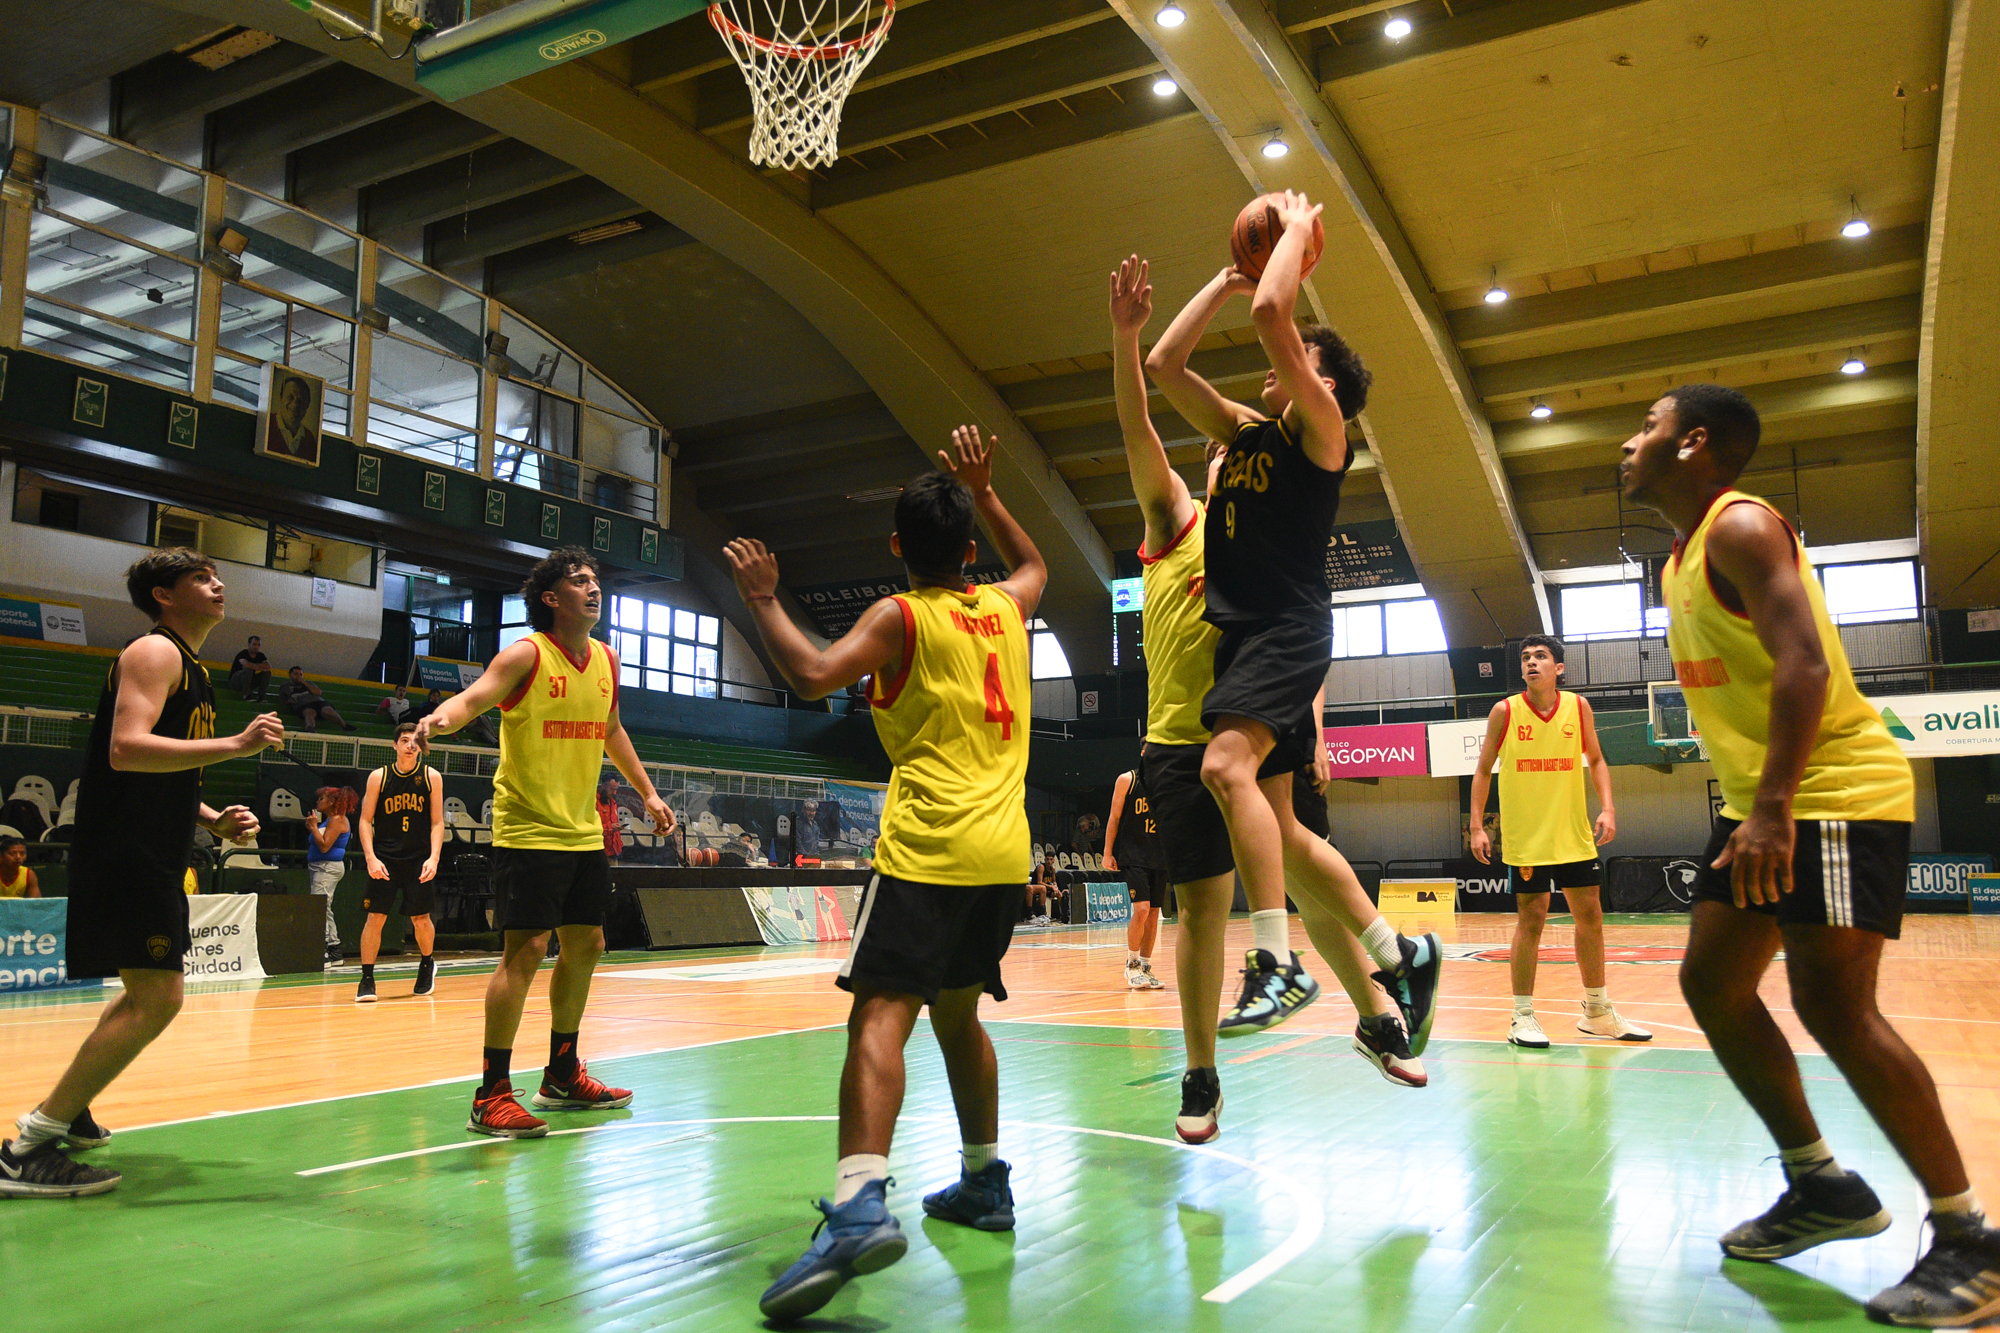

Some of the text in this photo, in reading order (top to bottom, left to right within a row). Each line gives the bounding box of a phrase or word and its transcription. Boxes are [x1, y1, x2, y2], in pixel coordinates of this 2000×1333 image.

[1225, 501, 1236, 540] 9
[799, 583, 906, 604] VOLEIBOL
[549, 675, 567, 699] 37
[984, 652, 1014, 741] 4
[1924, 704, 2000, 732] avali
[1517, 724, 1534, 742] 62
[1946, 737, 1993, 745] COBERTURA
[1323, 741, 1350, 749] ÉDICO
[384, 792, 425, 815] OBRAS
[402, 816, 410, 833] 5
[1145, 818, 1157, 834] 12
[191, 924, 241, 939] uenos
